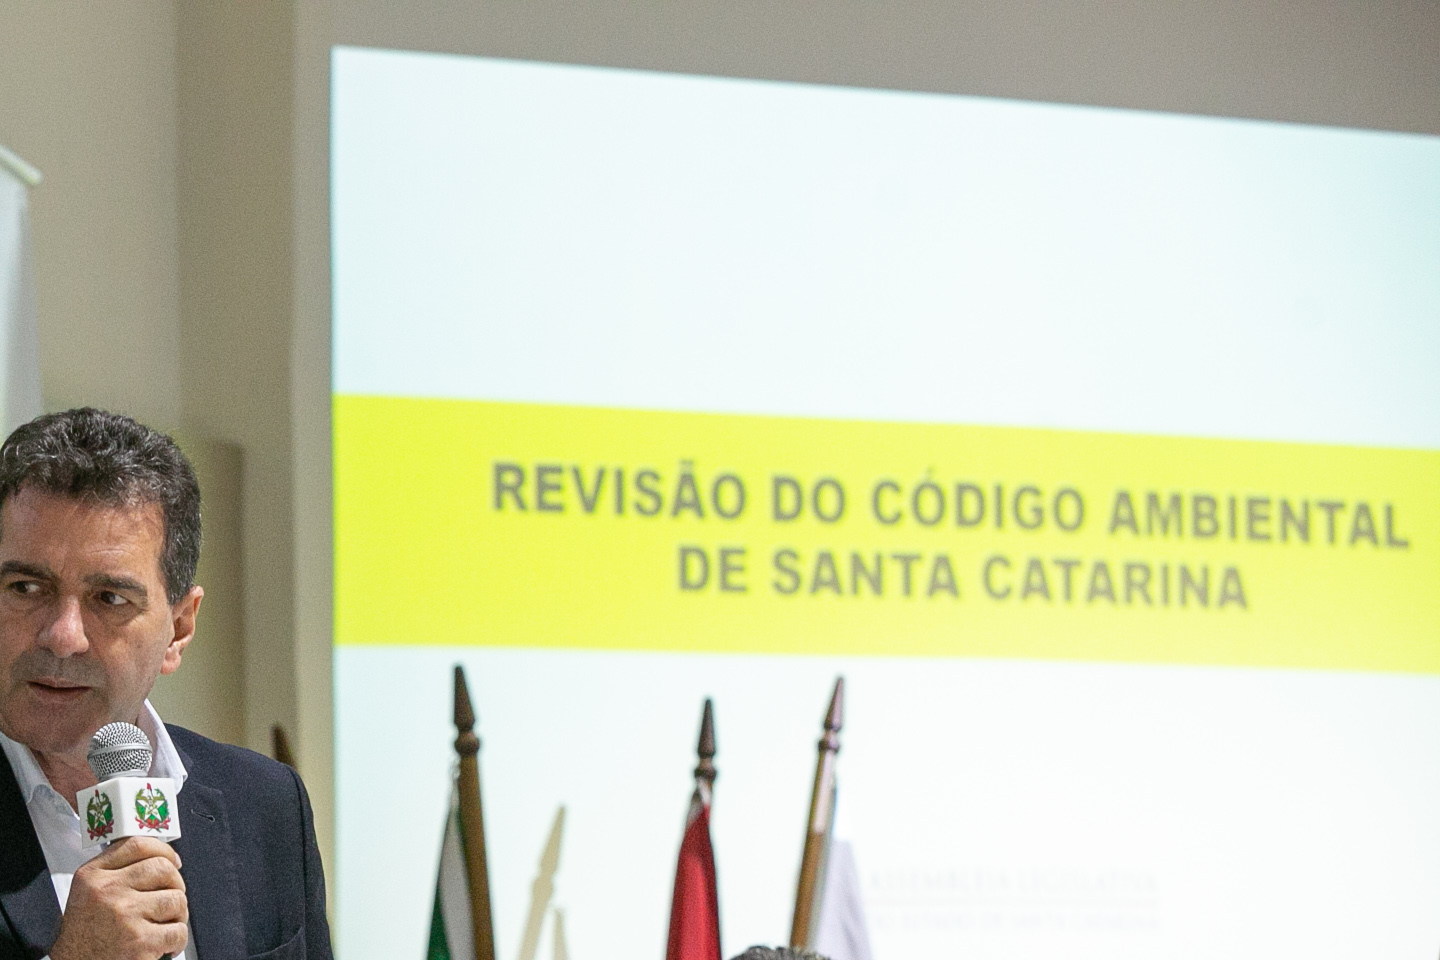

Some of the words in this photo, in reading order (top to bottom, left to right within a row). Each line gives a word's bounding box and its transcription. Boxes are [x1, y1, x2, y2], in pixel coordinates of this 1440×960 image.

[492, 459, 749, 522] REVISÃO
[771, 474, 847, 525] DO
[871, 467, 1087, 533] CÓDIGO
[1108, 489, 1411, 549] AMBIENTAL
[678, 545, 749, 593] DE
[772, 547, 960, 598] SANTA
[982, 554, 1248, 608] CATARINA
